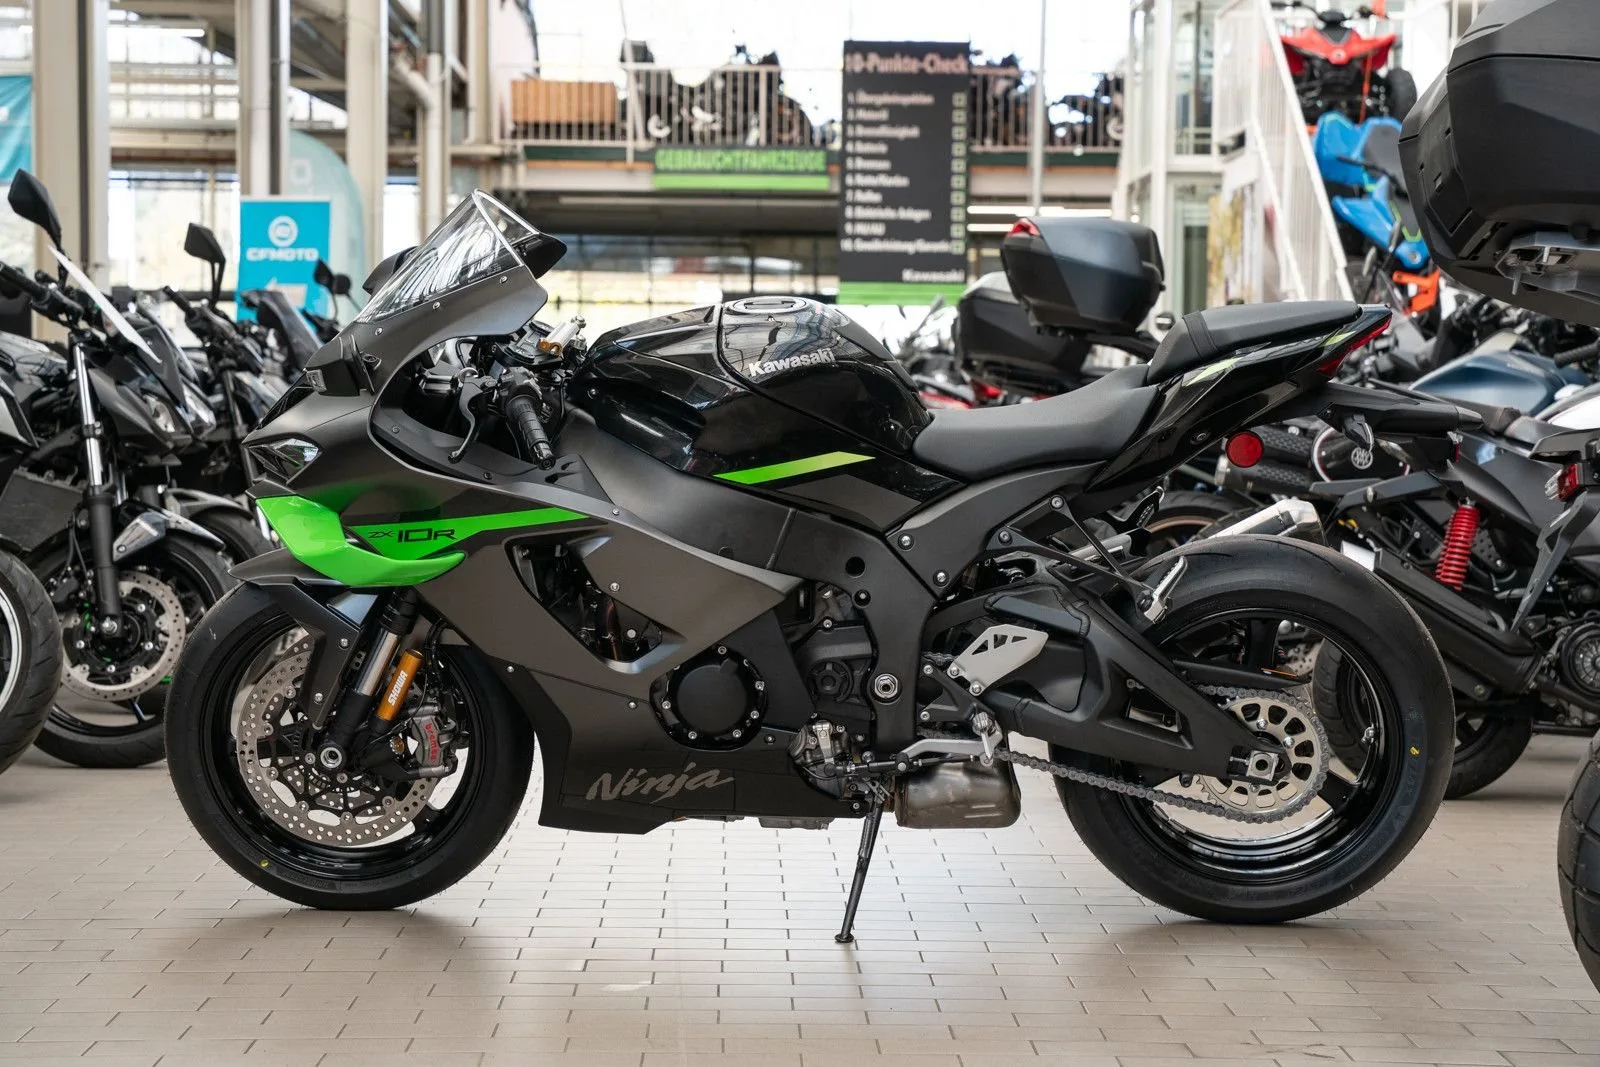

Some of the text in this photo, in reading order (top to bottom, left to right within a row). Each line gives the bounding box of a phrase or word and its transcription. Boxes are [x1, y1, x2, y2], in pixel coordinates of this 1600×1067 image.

[845, 52, 969, 74] 10-Punkte-Check
[655, 149, 827, 171] GEBRAUCHTFAHRZEUGE
[246, 248, 320, 262] CFMOTO
[902, 268, 965, 283] Kawasaki
[748, 347, 836, 377] Kawasaki
[397, 527, 458, 543] 10R
[387, 670, 409, 706] SHOWA
[585, 761, 735, 805] Ninja
